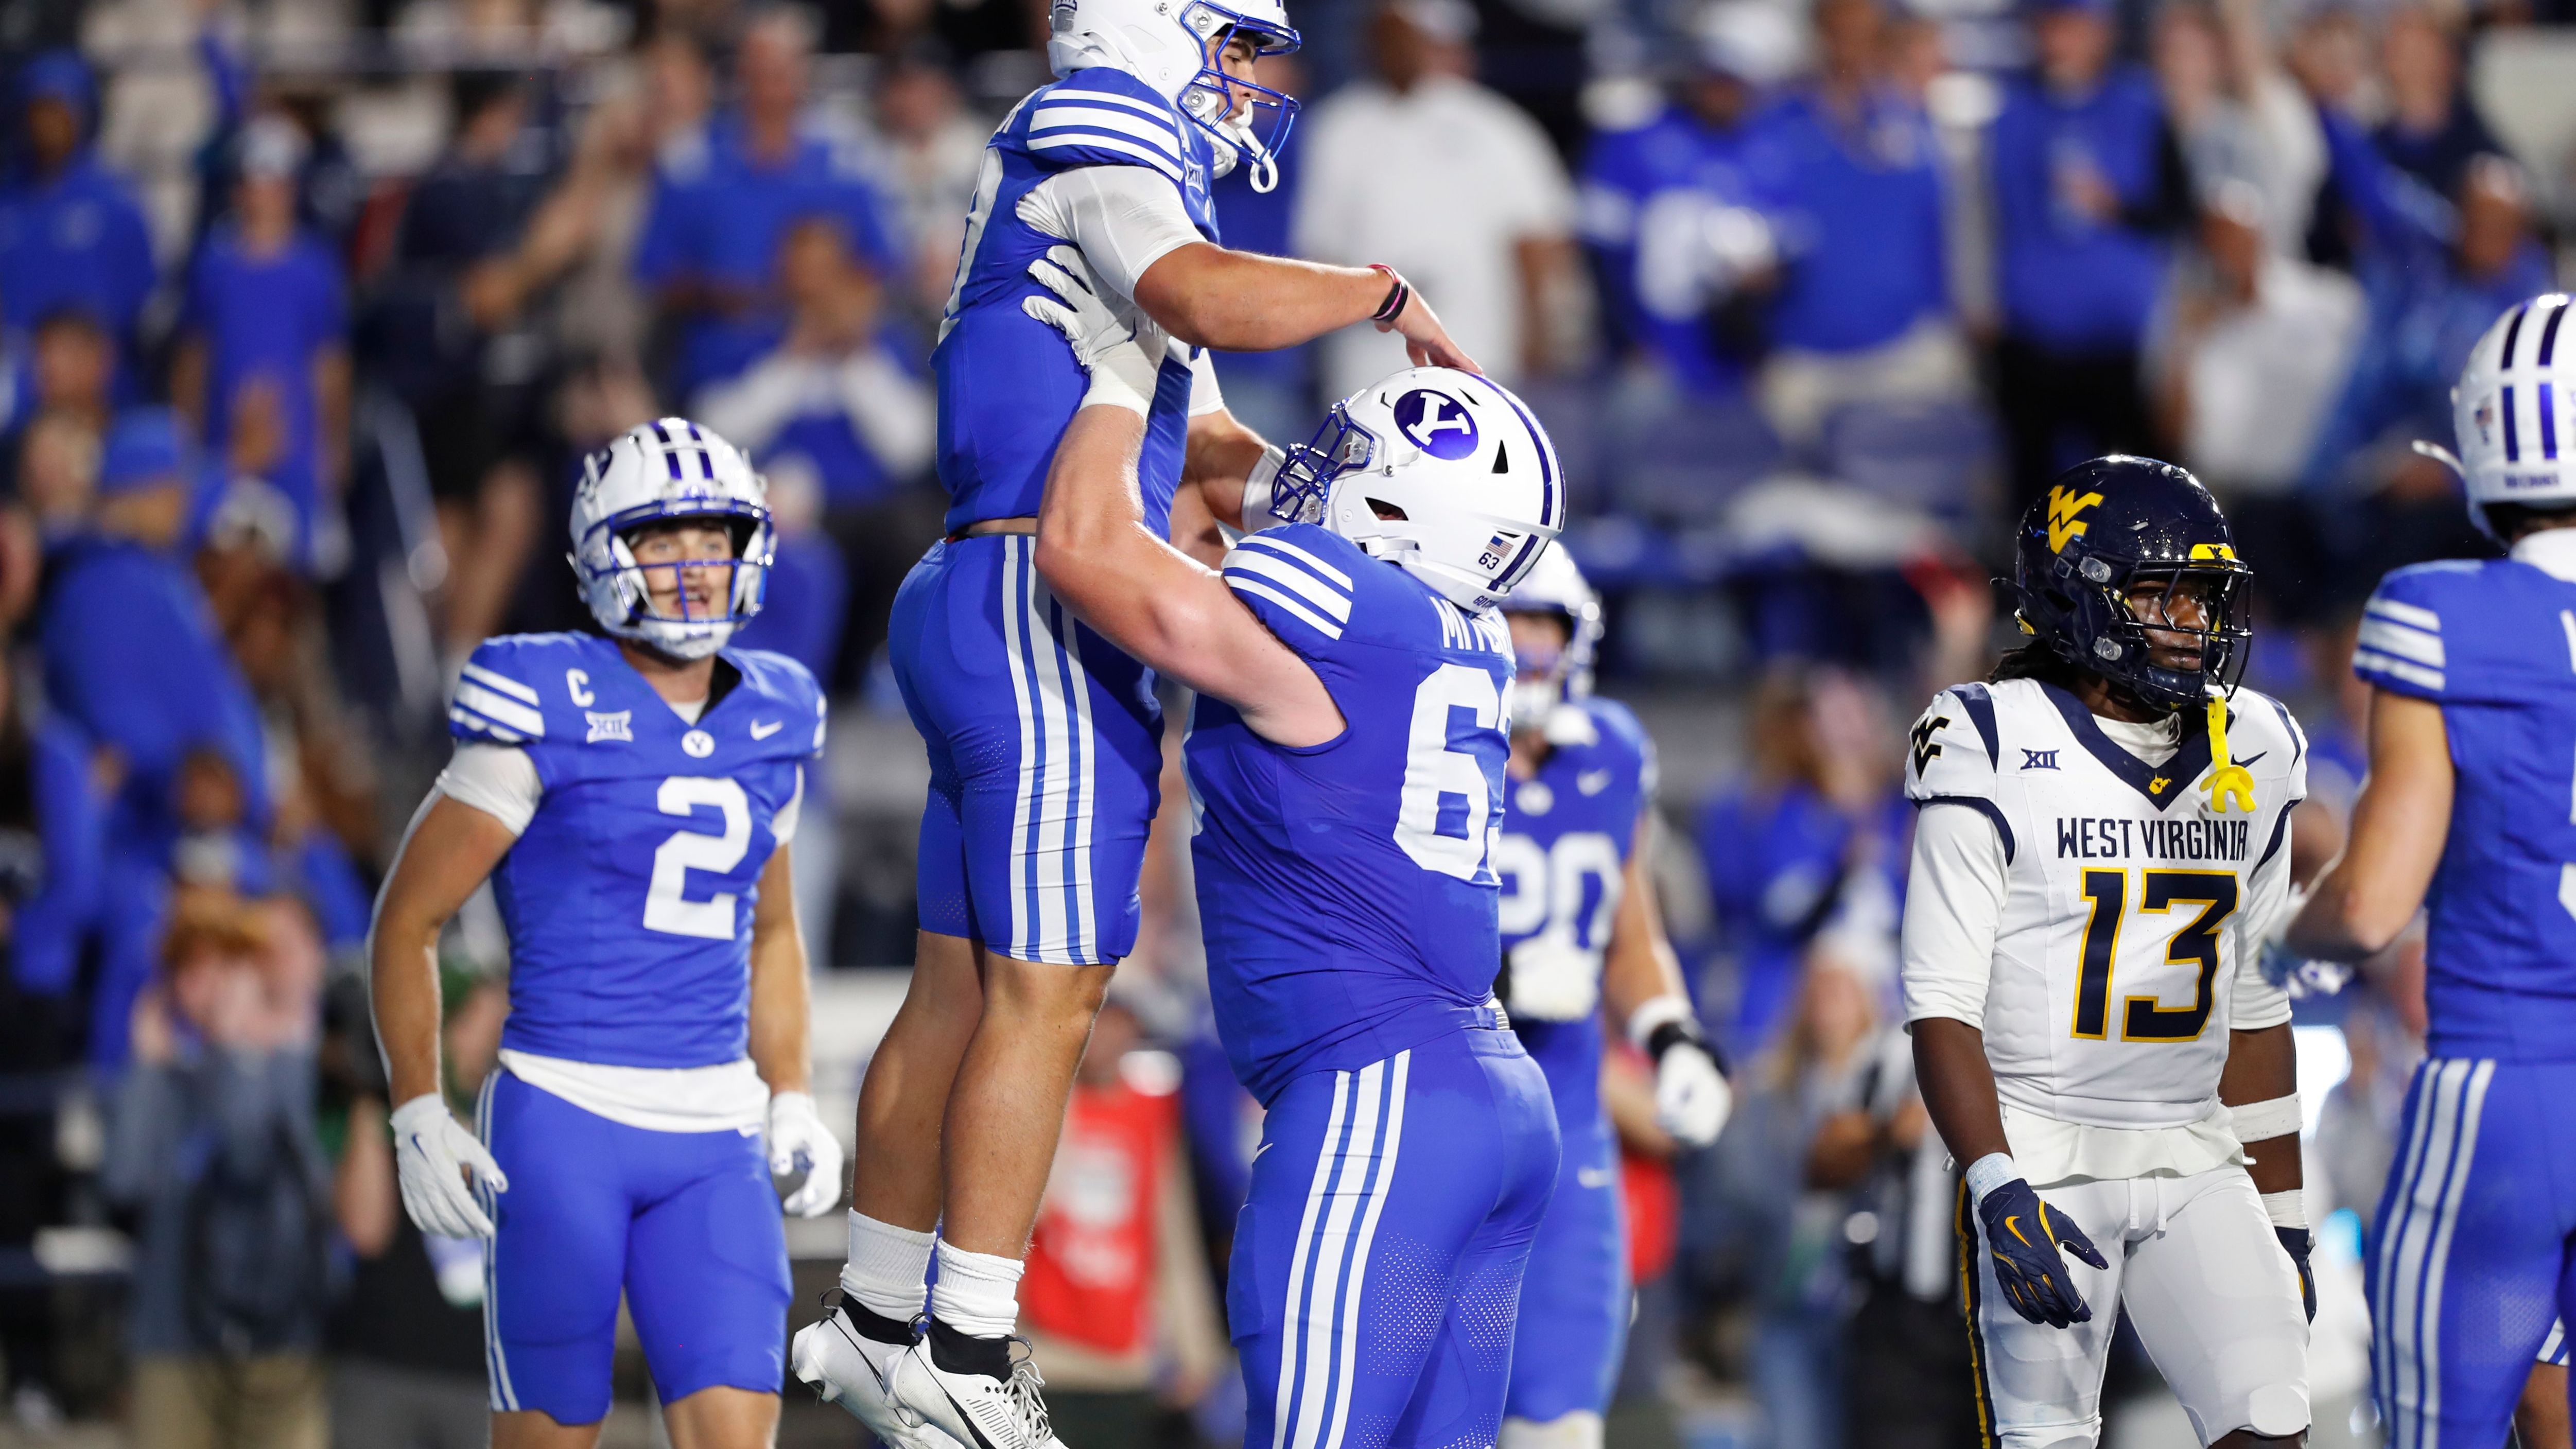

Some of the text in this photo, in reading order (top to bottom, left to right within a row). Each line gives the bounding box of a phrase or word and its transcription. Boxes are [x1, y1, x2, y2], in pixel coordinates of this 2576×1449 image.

[1406, 392, 1471, 447] Y
[1478, 552, 1500, 570] 63
[566, 668, 595, 707] C
[2021, 748, 2061, 771] XII
[643, 775, 753, 940] 2
[2057, 818, 2249, 861] WEST VIRGINIA
[2070, 867, 2240, 1042] 13
